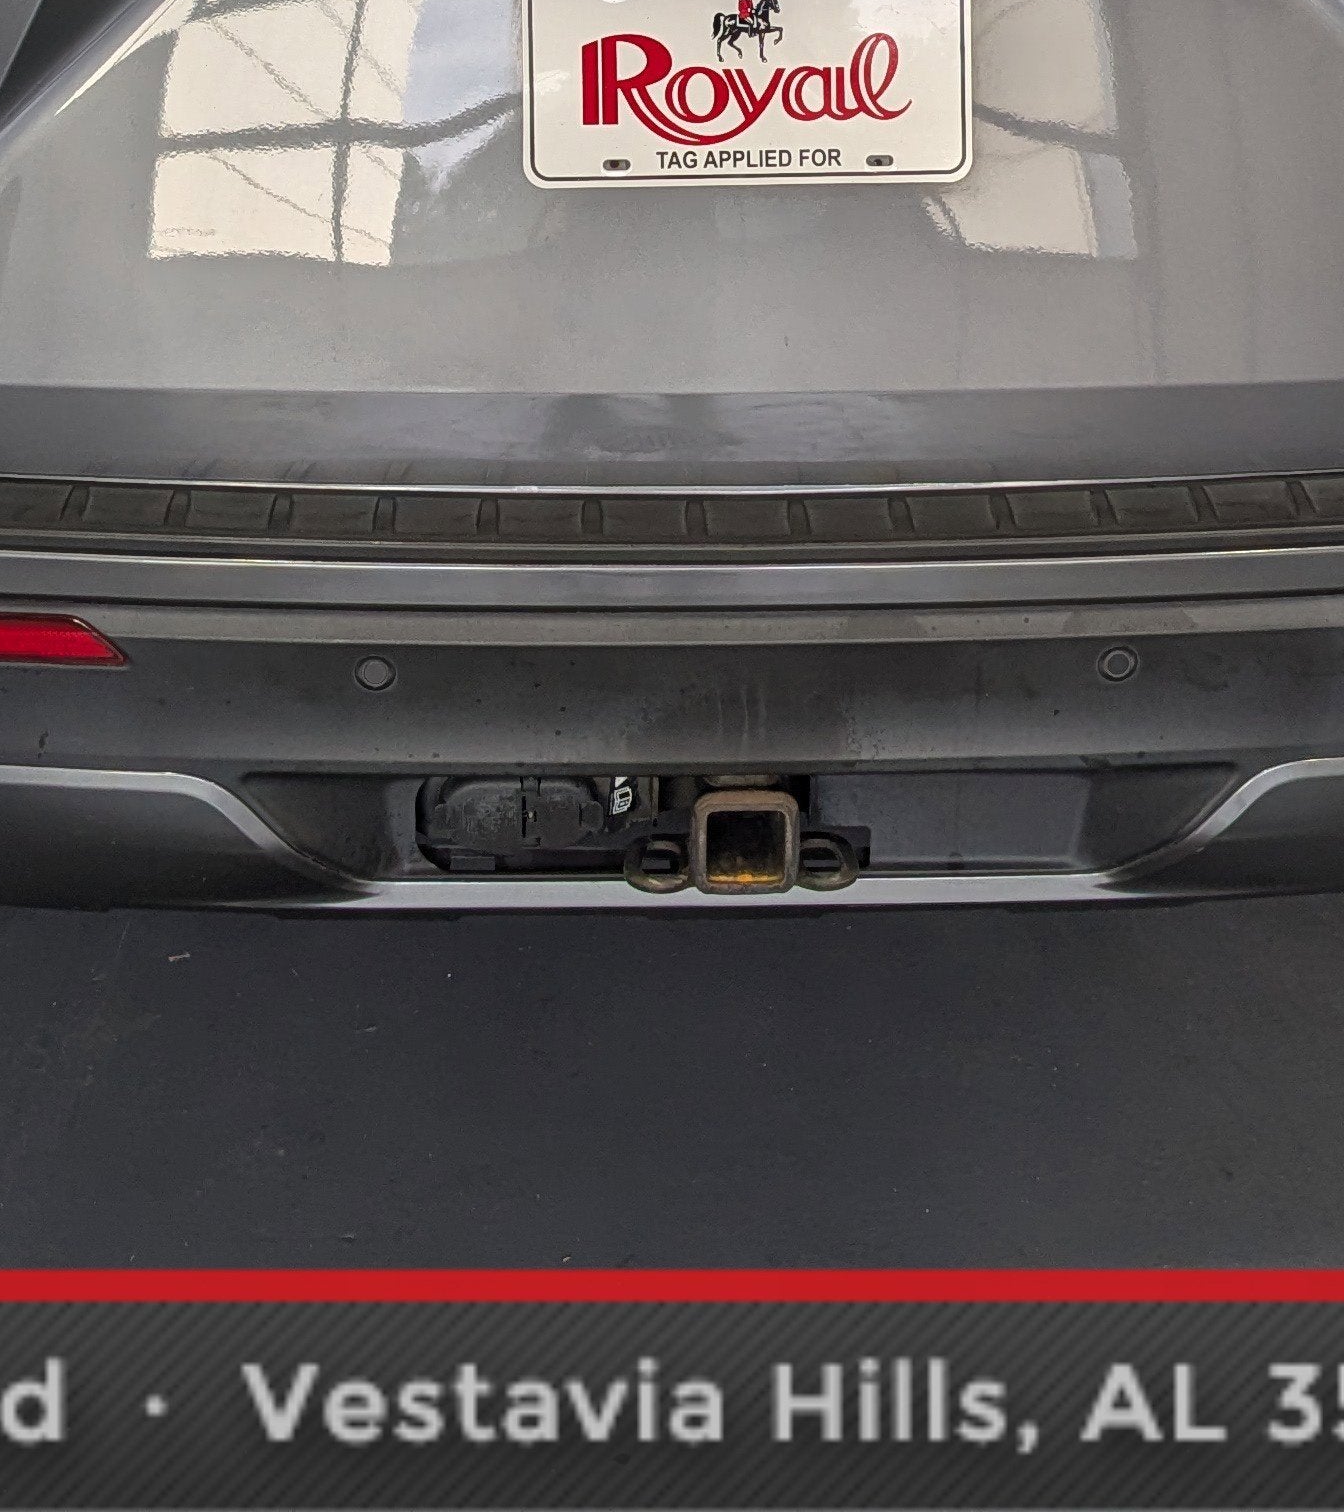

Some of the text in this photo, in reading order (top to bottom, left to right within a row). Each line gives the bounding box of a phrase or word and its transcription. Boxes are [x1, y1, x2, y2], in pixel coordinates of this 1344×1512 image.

[581, 32, 913, 146] Royal
[656, 148, 842, 170] TAG APPLIED FOR
